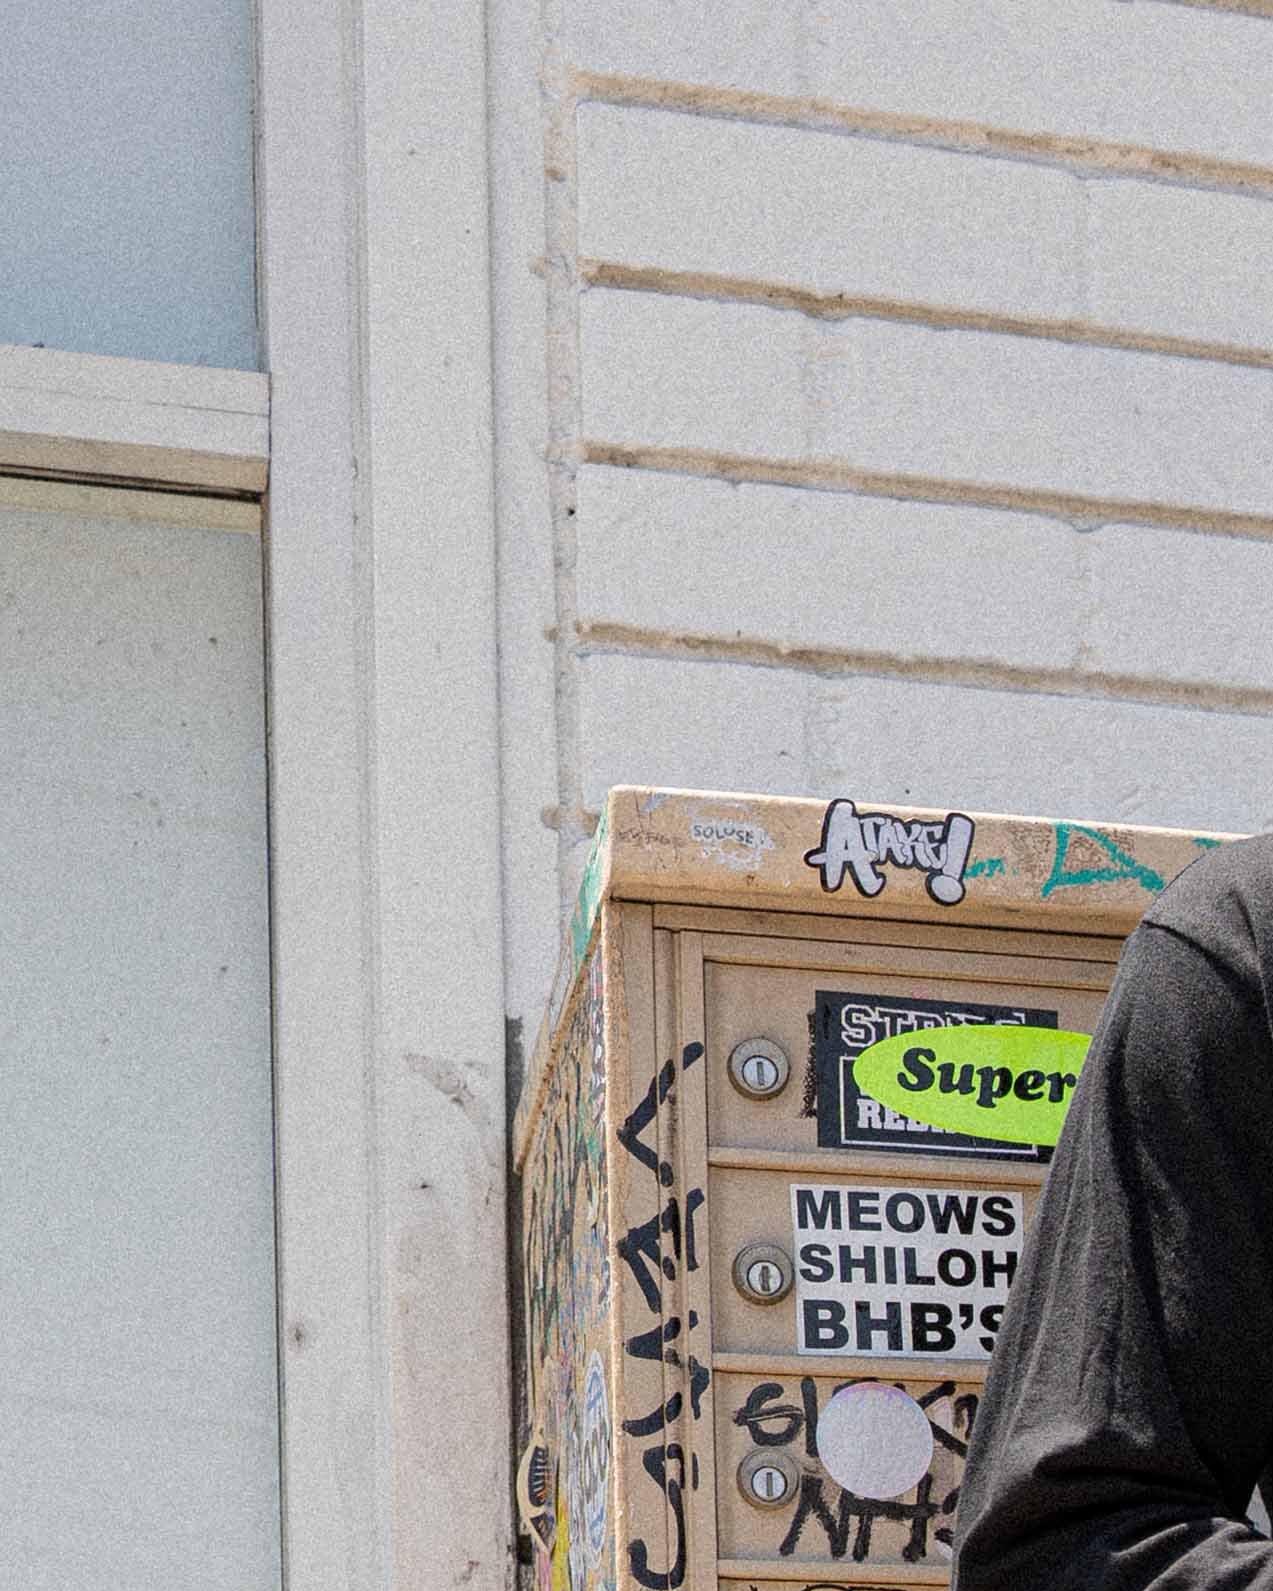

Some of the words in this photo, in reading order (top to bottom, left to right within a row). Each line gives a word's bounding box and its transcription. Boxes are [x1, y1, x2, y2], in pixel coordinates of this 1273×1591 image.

[897, 1047, 1077, 1108] Super
[797, 1190, 1016, 1236] MEOWS
[800, 1244, 1018, 1289] SHILOH
